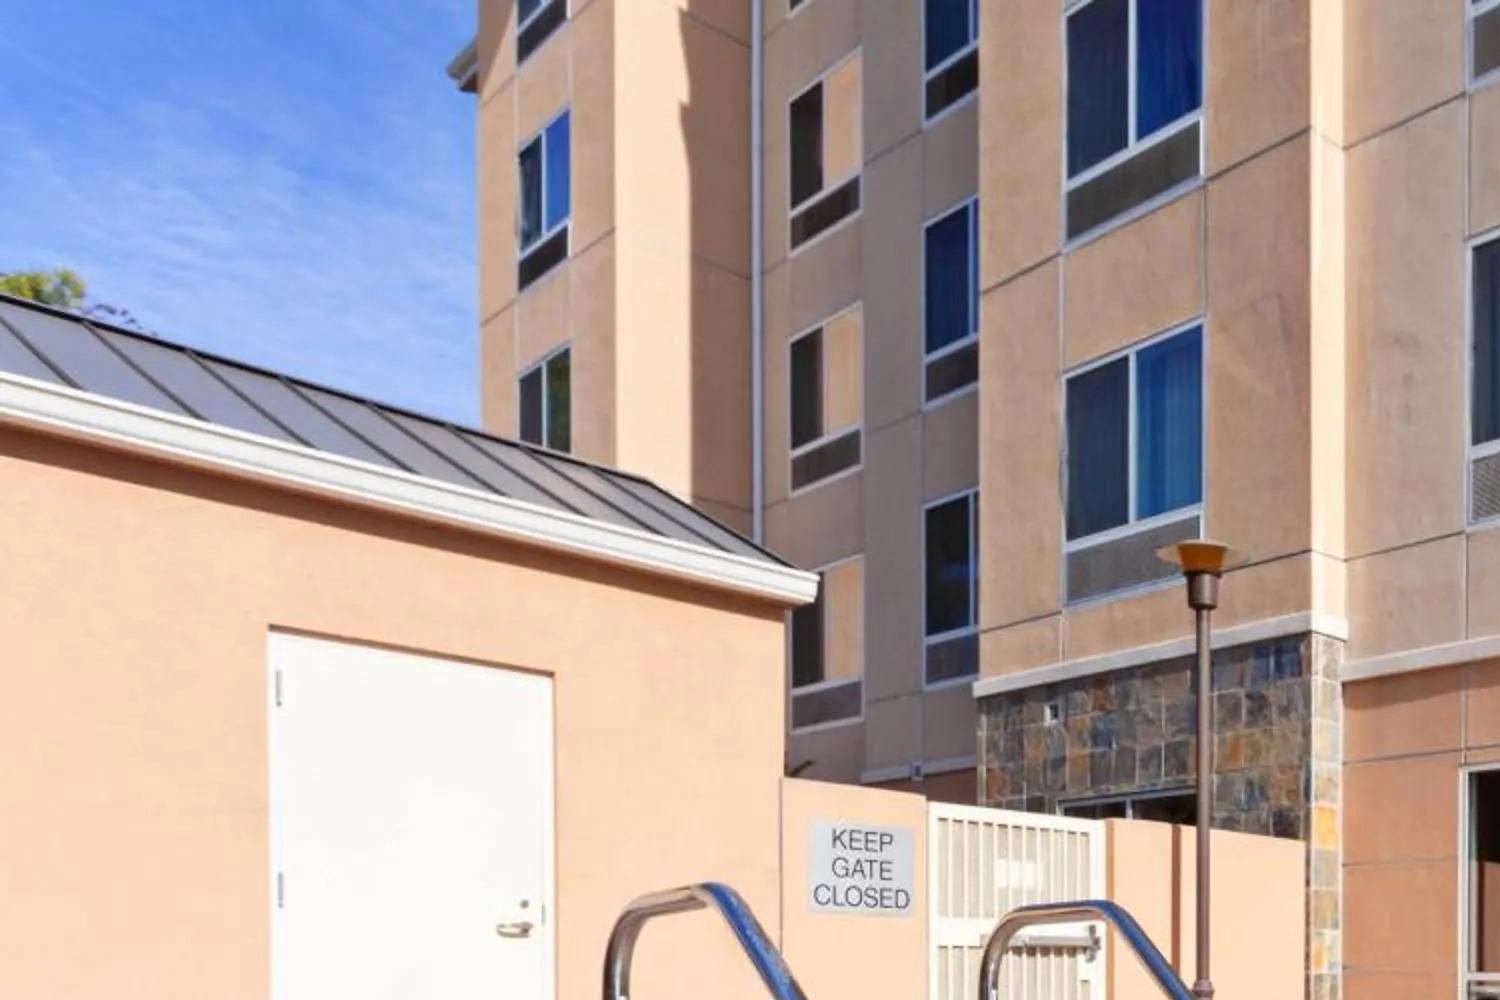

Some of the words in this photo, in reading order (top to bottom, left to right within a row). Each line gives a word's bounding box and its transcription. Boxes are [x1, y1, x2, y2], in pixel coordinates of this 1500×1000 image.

[831, 827, 894, 853] KEEP
[831, 856, 894, 881] GATE
[813, 883, 911, 909] CLOSED
